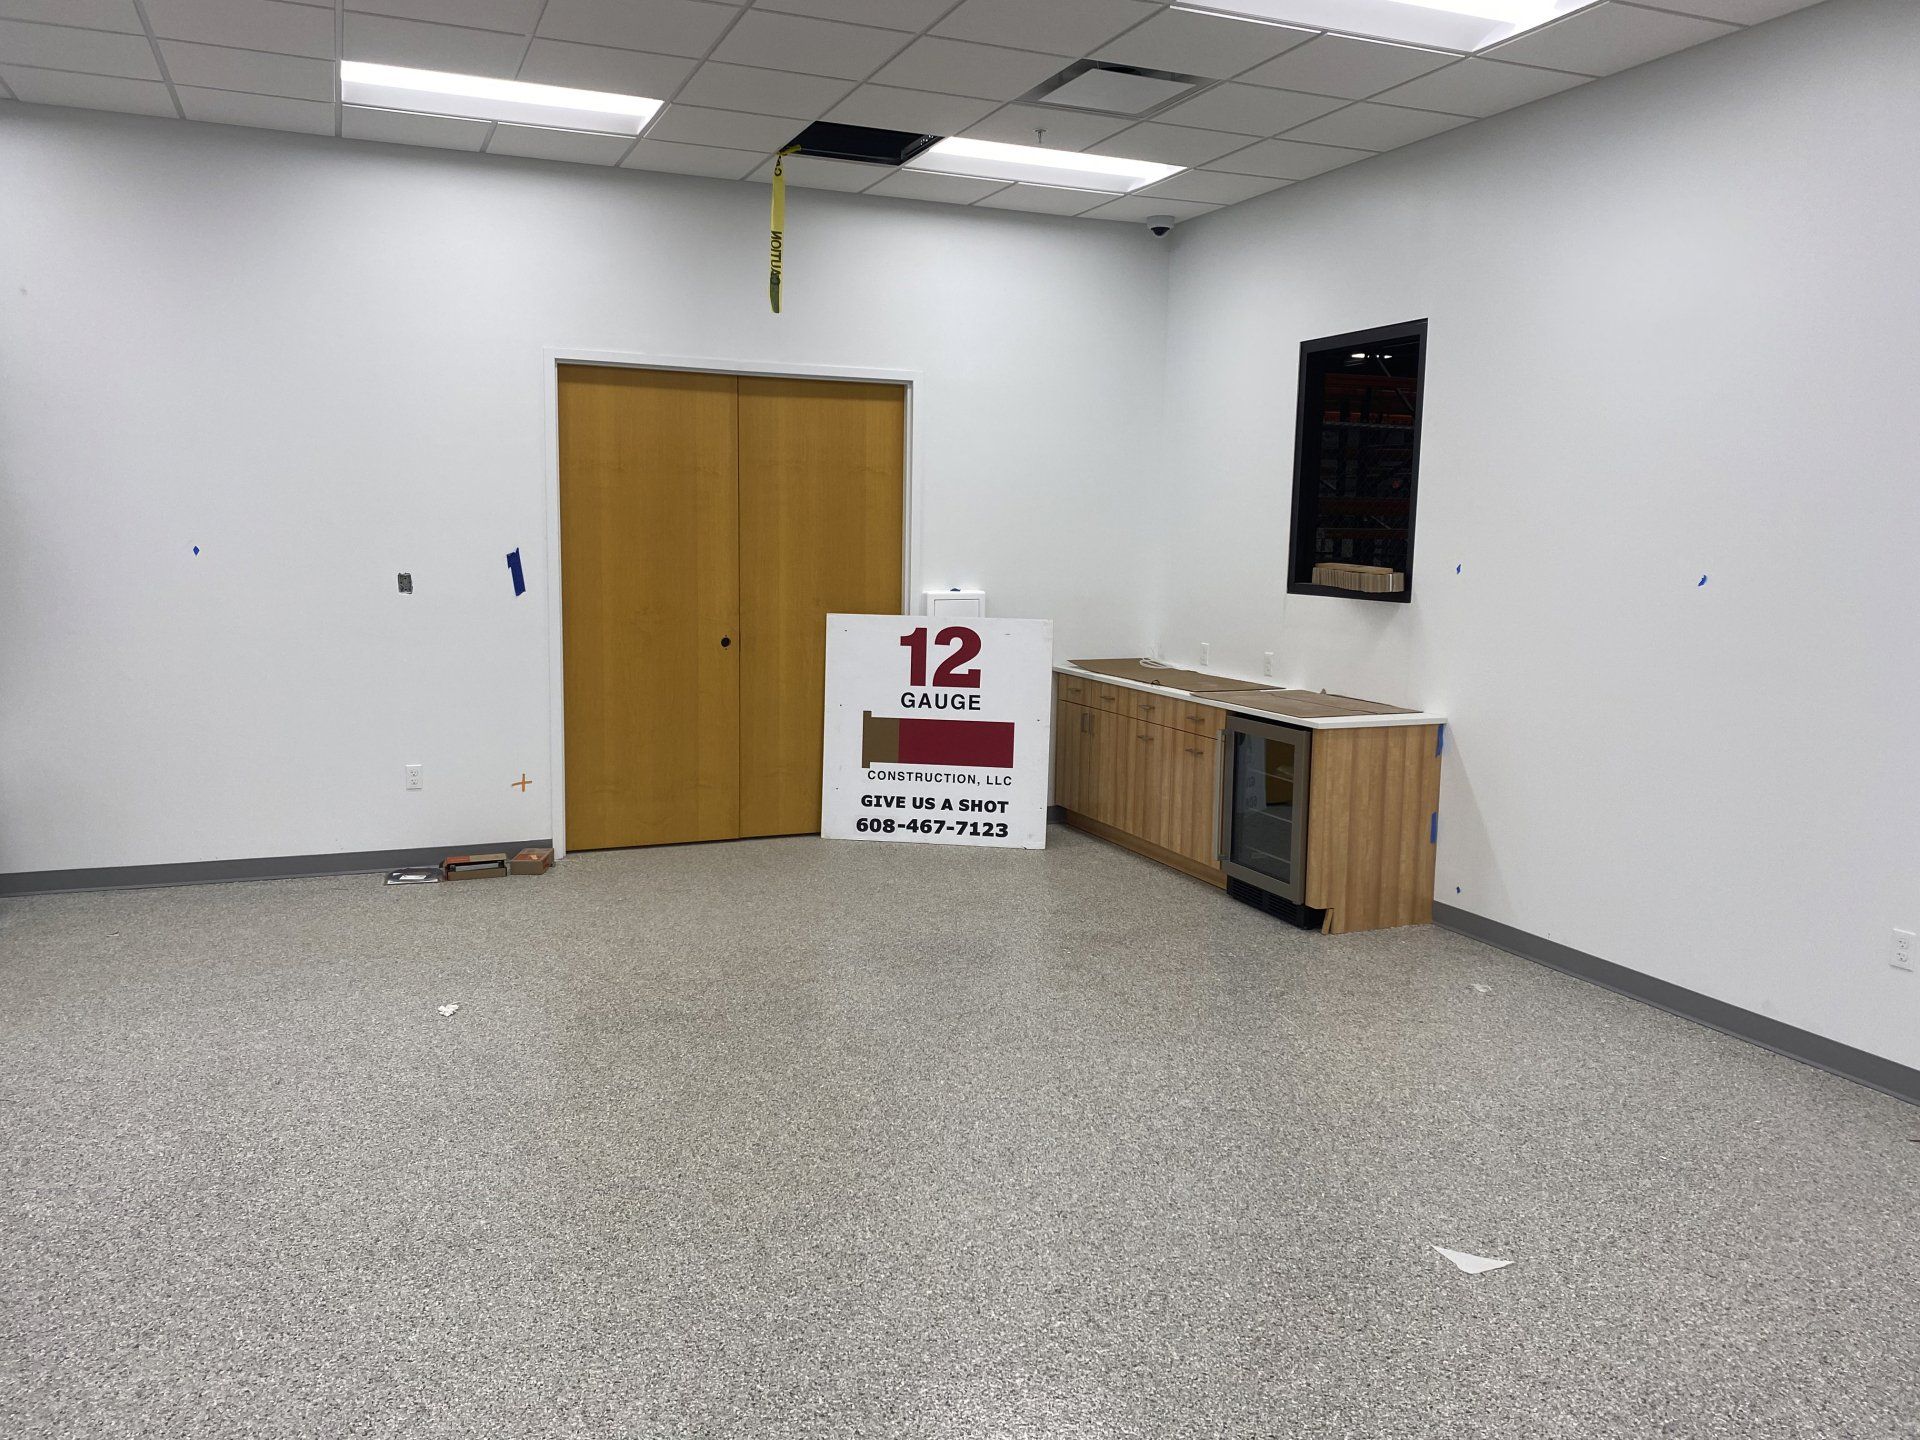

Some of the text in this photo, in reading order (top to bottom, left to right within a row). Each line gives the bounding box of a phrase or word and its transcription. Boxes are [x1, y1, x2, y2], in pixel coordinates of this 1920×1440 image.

[900, 626, 981, 688] 12
[901, 692, 981, 711] GAUGE
[868, 770, 1012, 786] CONSTRUCTION, LLC
[861, 795, 1008, 813] GIVE US A SHOT
[856, 818, 1008, 838] 608-467-7123
